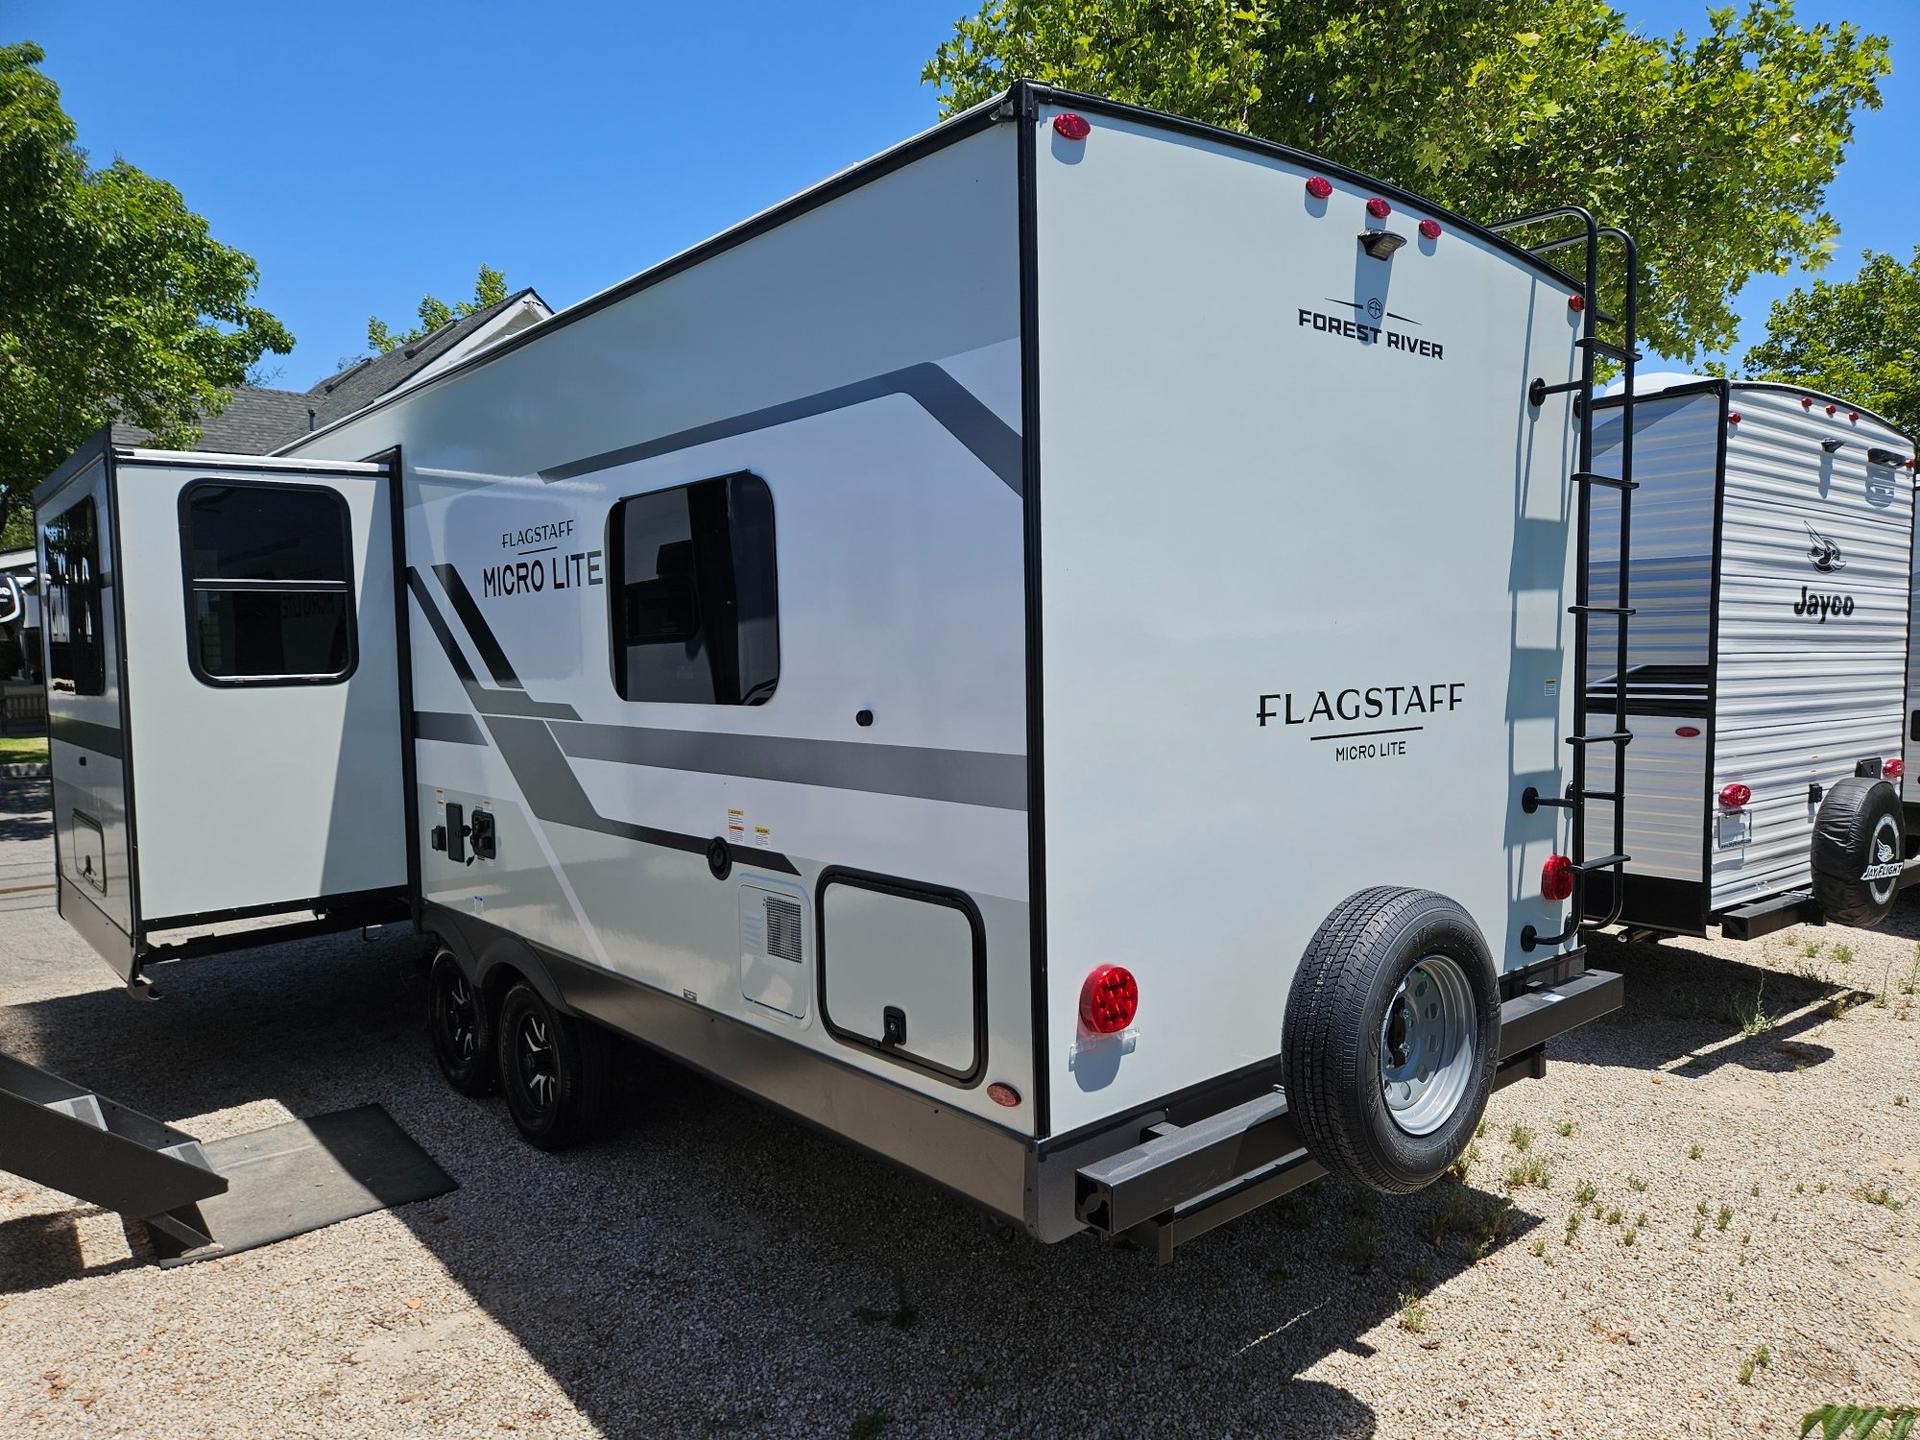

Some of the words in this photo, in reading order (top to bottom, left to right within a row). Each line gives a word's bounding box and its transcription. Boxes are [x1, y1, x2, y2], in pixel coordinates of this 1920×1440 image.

[1298, 308, 1382, 344] FOREST
[1386, 331, 1444, 361] RIVER
[501, 519, 575, 549] FLAGSTAFF
[483, 559, 545, 598] MICRO
[552, 550, 604, 590] LITE
[1794, 585, 1855, 624] Jayco
[1256, 682, 1466, 727] FLAGSTAFF
[1335, 743, 1376, 762] MICRO
[1380, 741, 1407, 757] LITE
